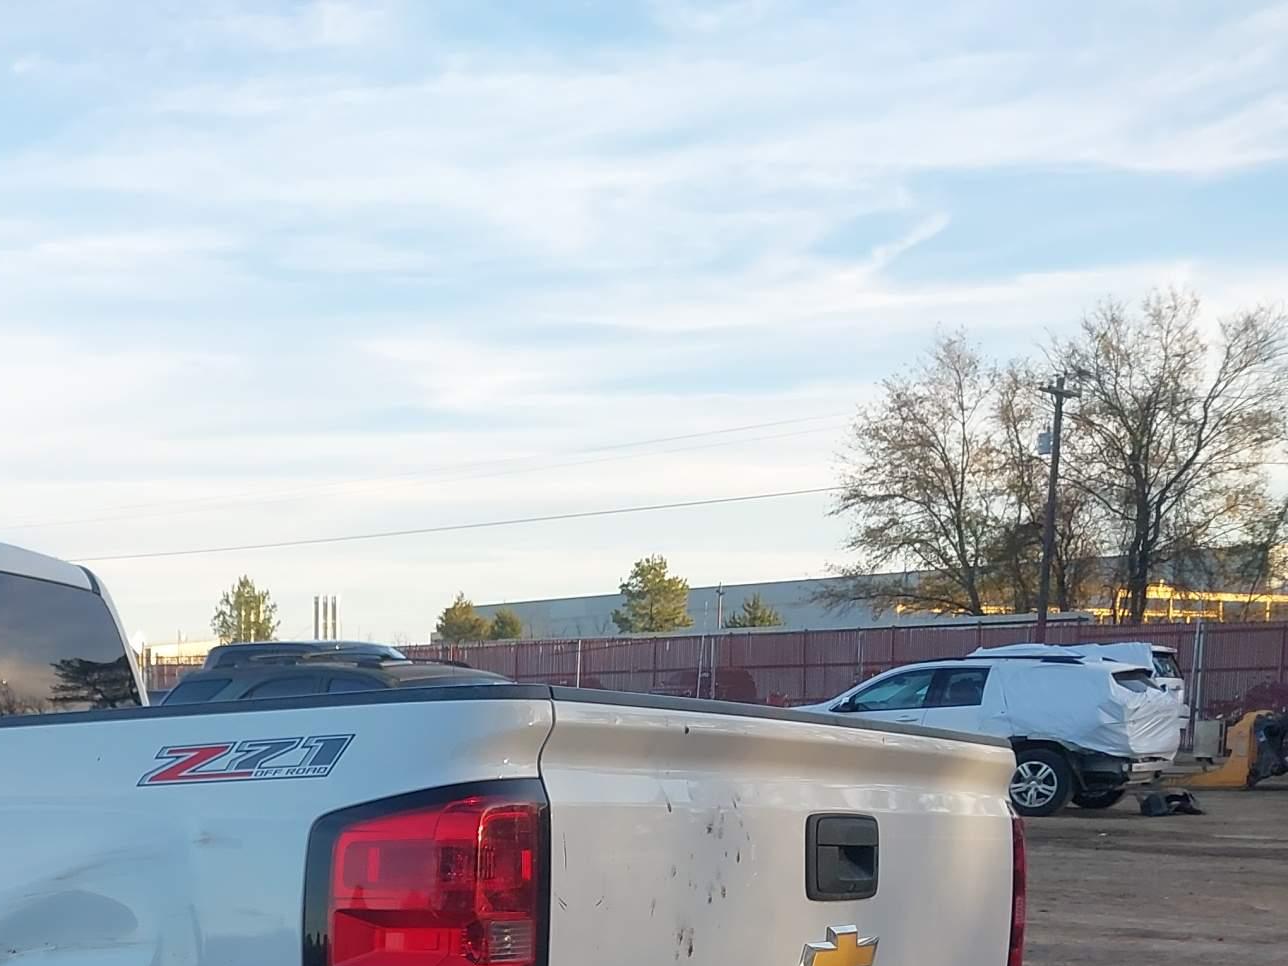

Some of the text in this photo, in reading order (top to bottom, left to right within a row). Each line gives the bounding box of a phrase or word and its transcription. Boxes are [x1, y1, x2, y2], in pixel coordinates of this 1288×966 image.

[136, 734, 356, 787] Z71
[254, 766, 328, 777] OFF ROAD
